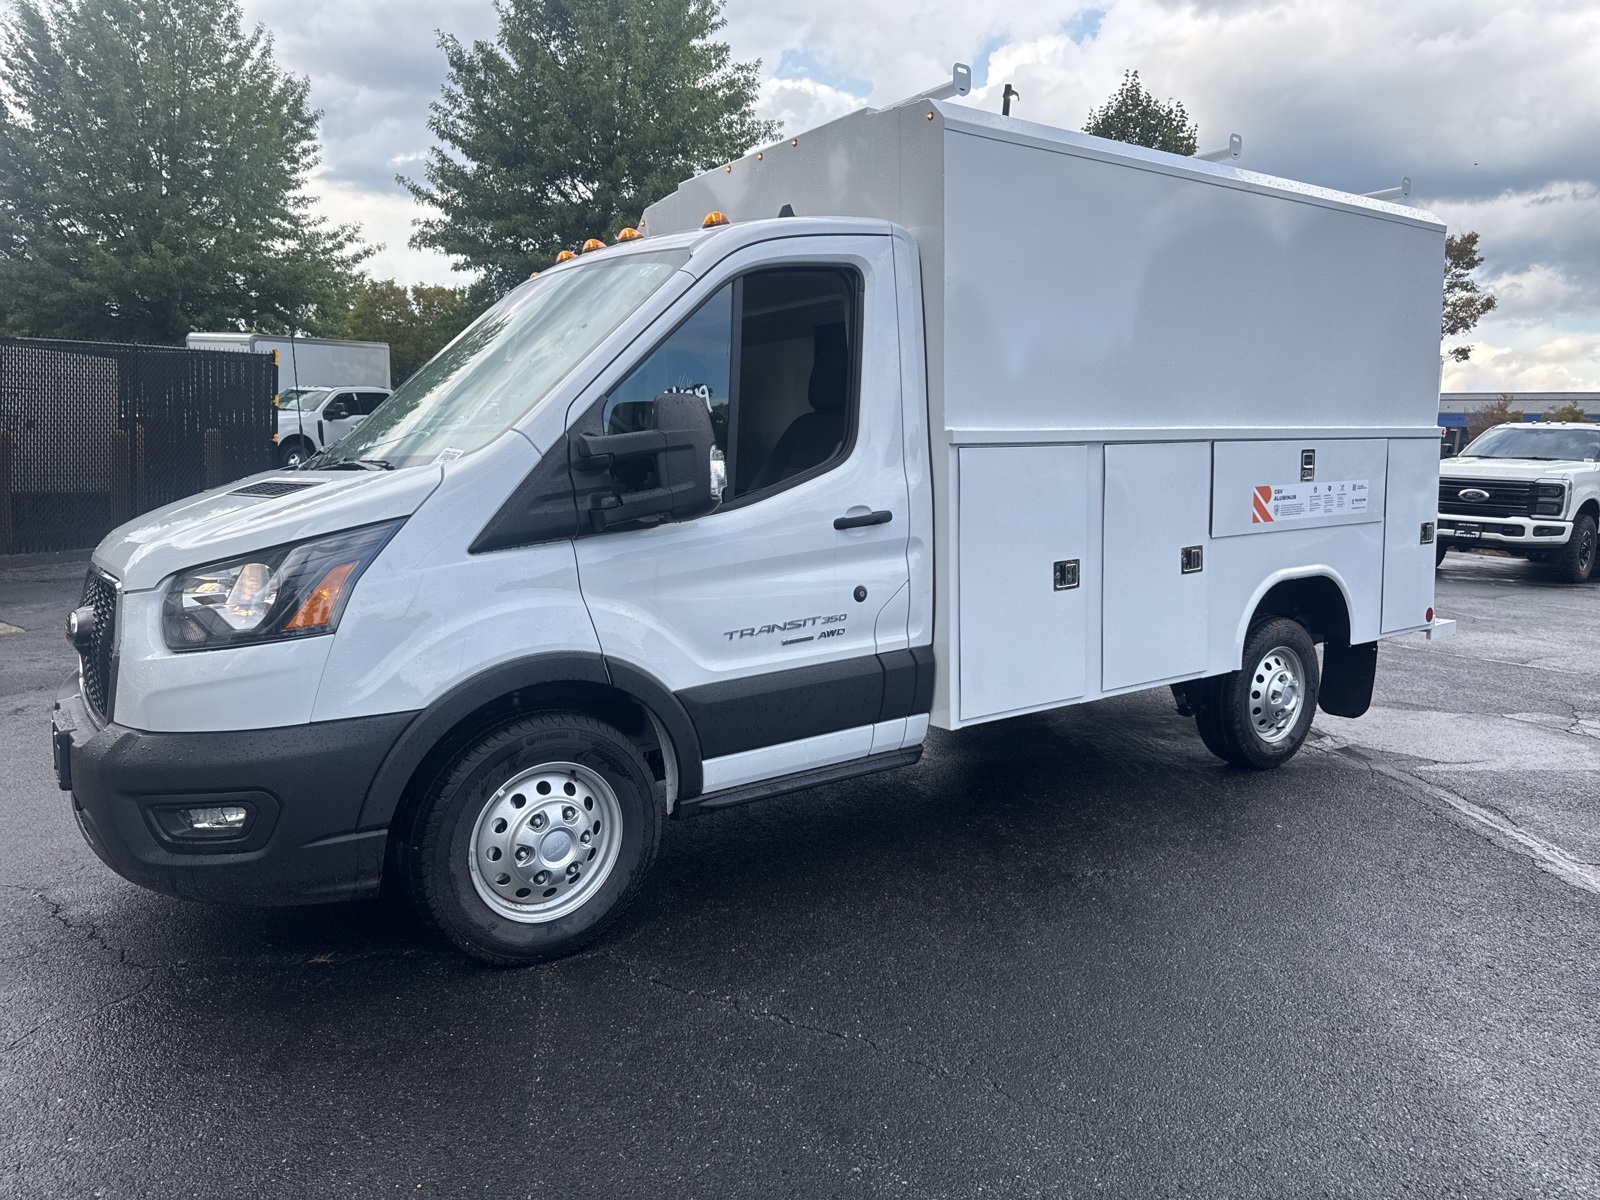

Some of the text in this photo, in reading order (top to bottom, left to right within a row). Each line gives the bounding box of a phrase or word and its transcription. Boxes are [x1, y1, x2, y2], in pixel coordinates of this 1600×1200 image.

[723, 613, 848, 641] TRANSIT 350
[817, 628, 846, 640] AWD
[526, 730, 569, 746] Continental
